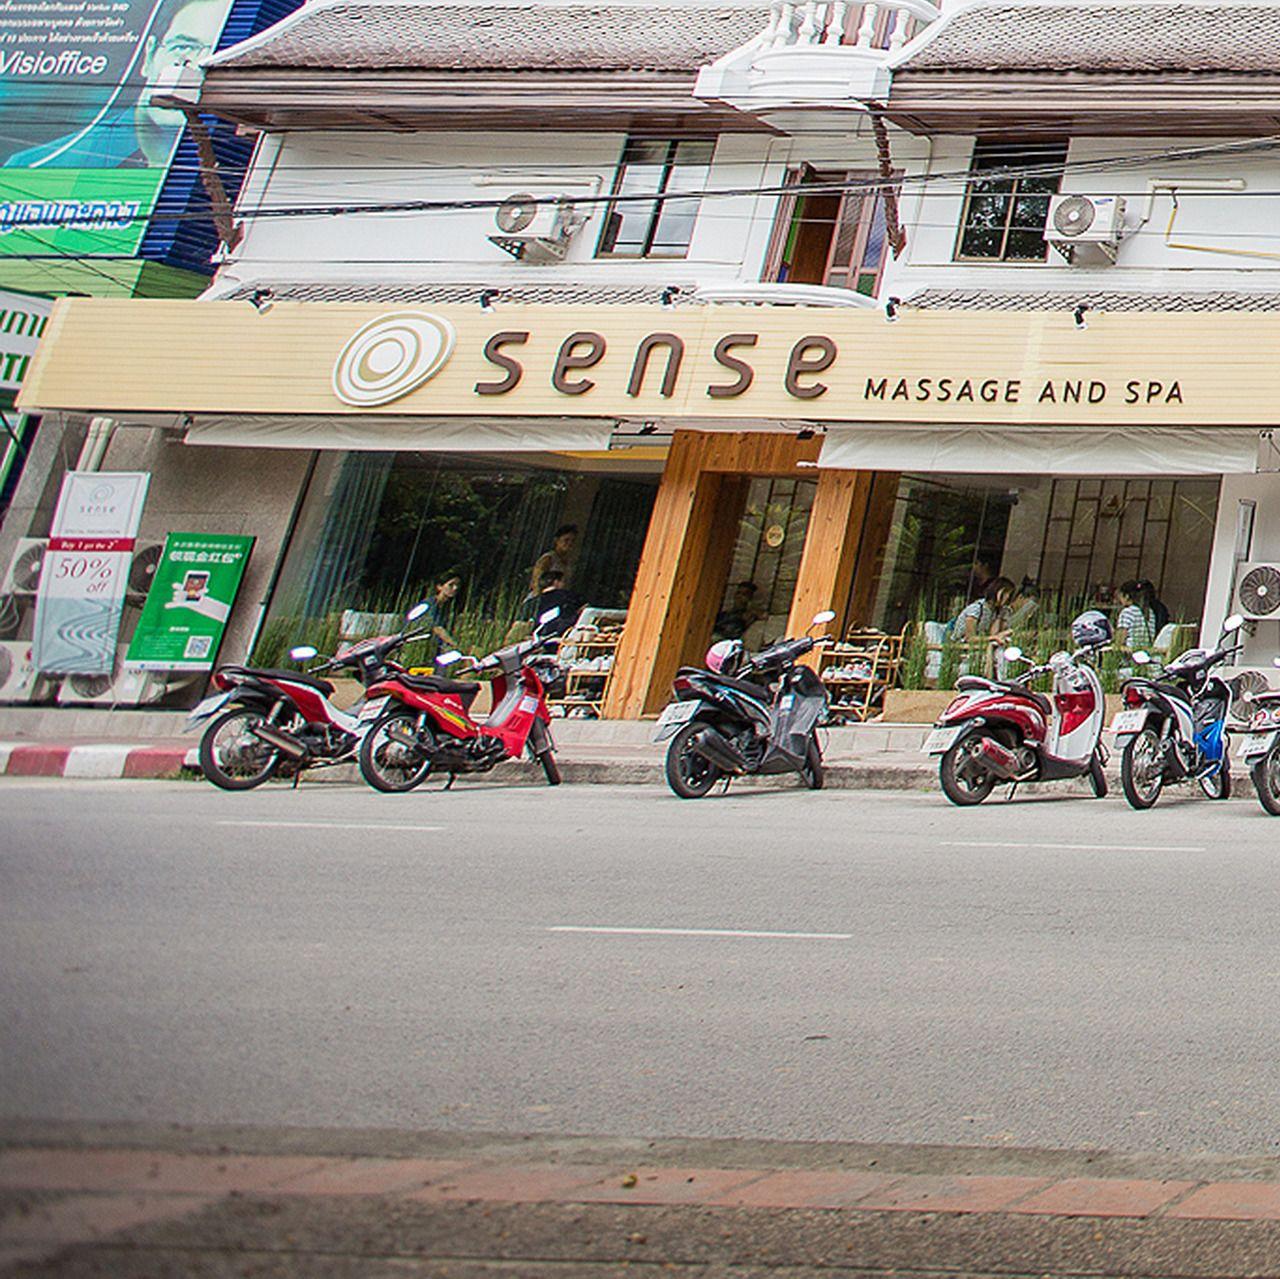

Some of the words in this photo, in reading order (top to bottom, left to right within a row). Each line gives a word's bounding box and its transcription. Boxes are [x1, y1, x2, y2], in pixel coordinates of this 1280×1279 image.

[474, 331, 838, 399] sense
[864, 378, 1021, 404] MASSAGE
[1039, 380, 1106, 404] AND
[1125, 380, 1183, 404] SPA
[55, 557, 113, 580] 50%
[86, 582, 108, 594] off
